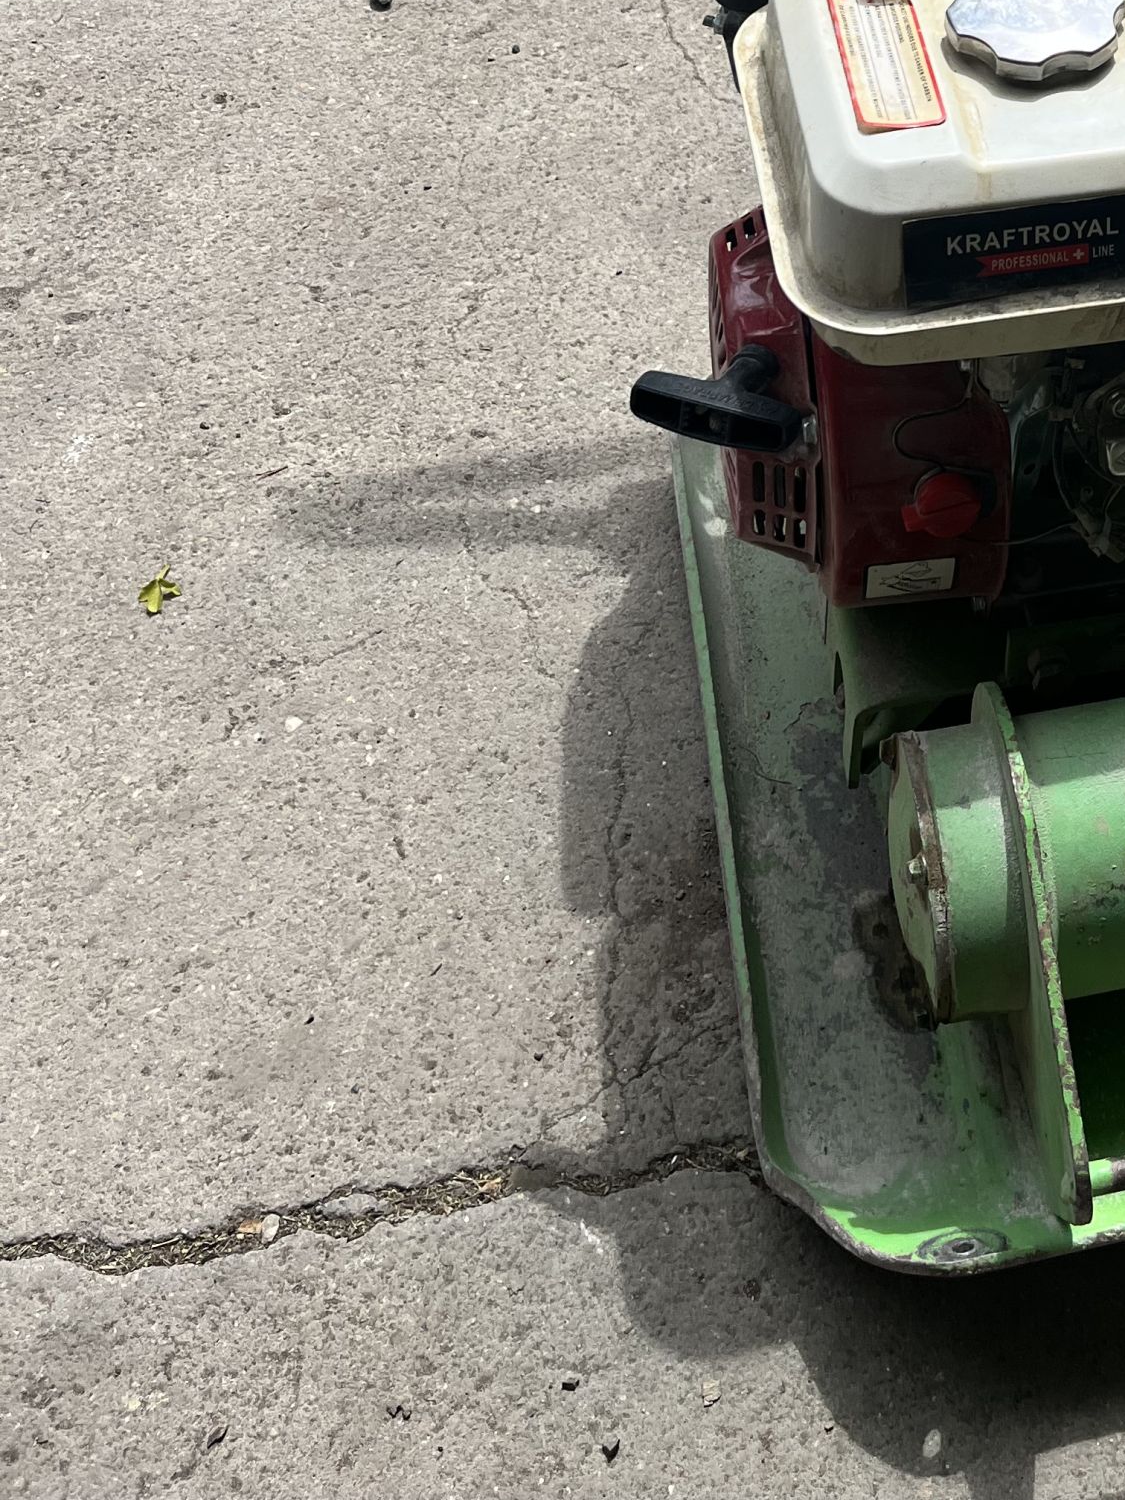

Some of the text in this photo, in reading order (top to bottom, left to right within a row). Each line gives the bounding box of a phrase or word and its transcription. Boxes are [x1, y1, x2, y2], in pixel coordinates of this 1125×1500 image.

[946, 217, 1119, 256] KRAFTROYAL
[991, 244, 1115, 271] PROFESSIONAL LINE
